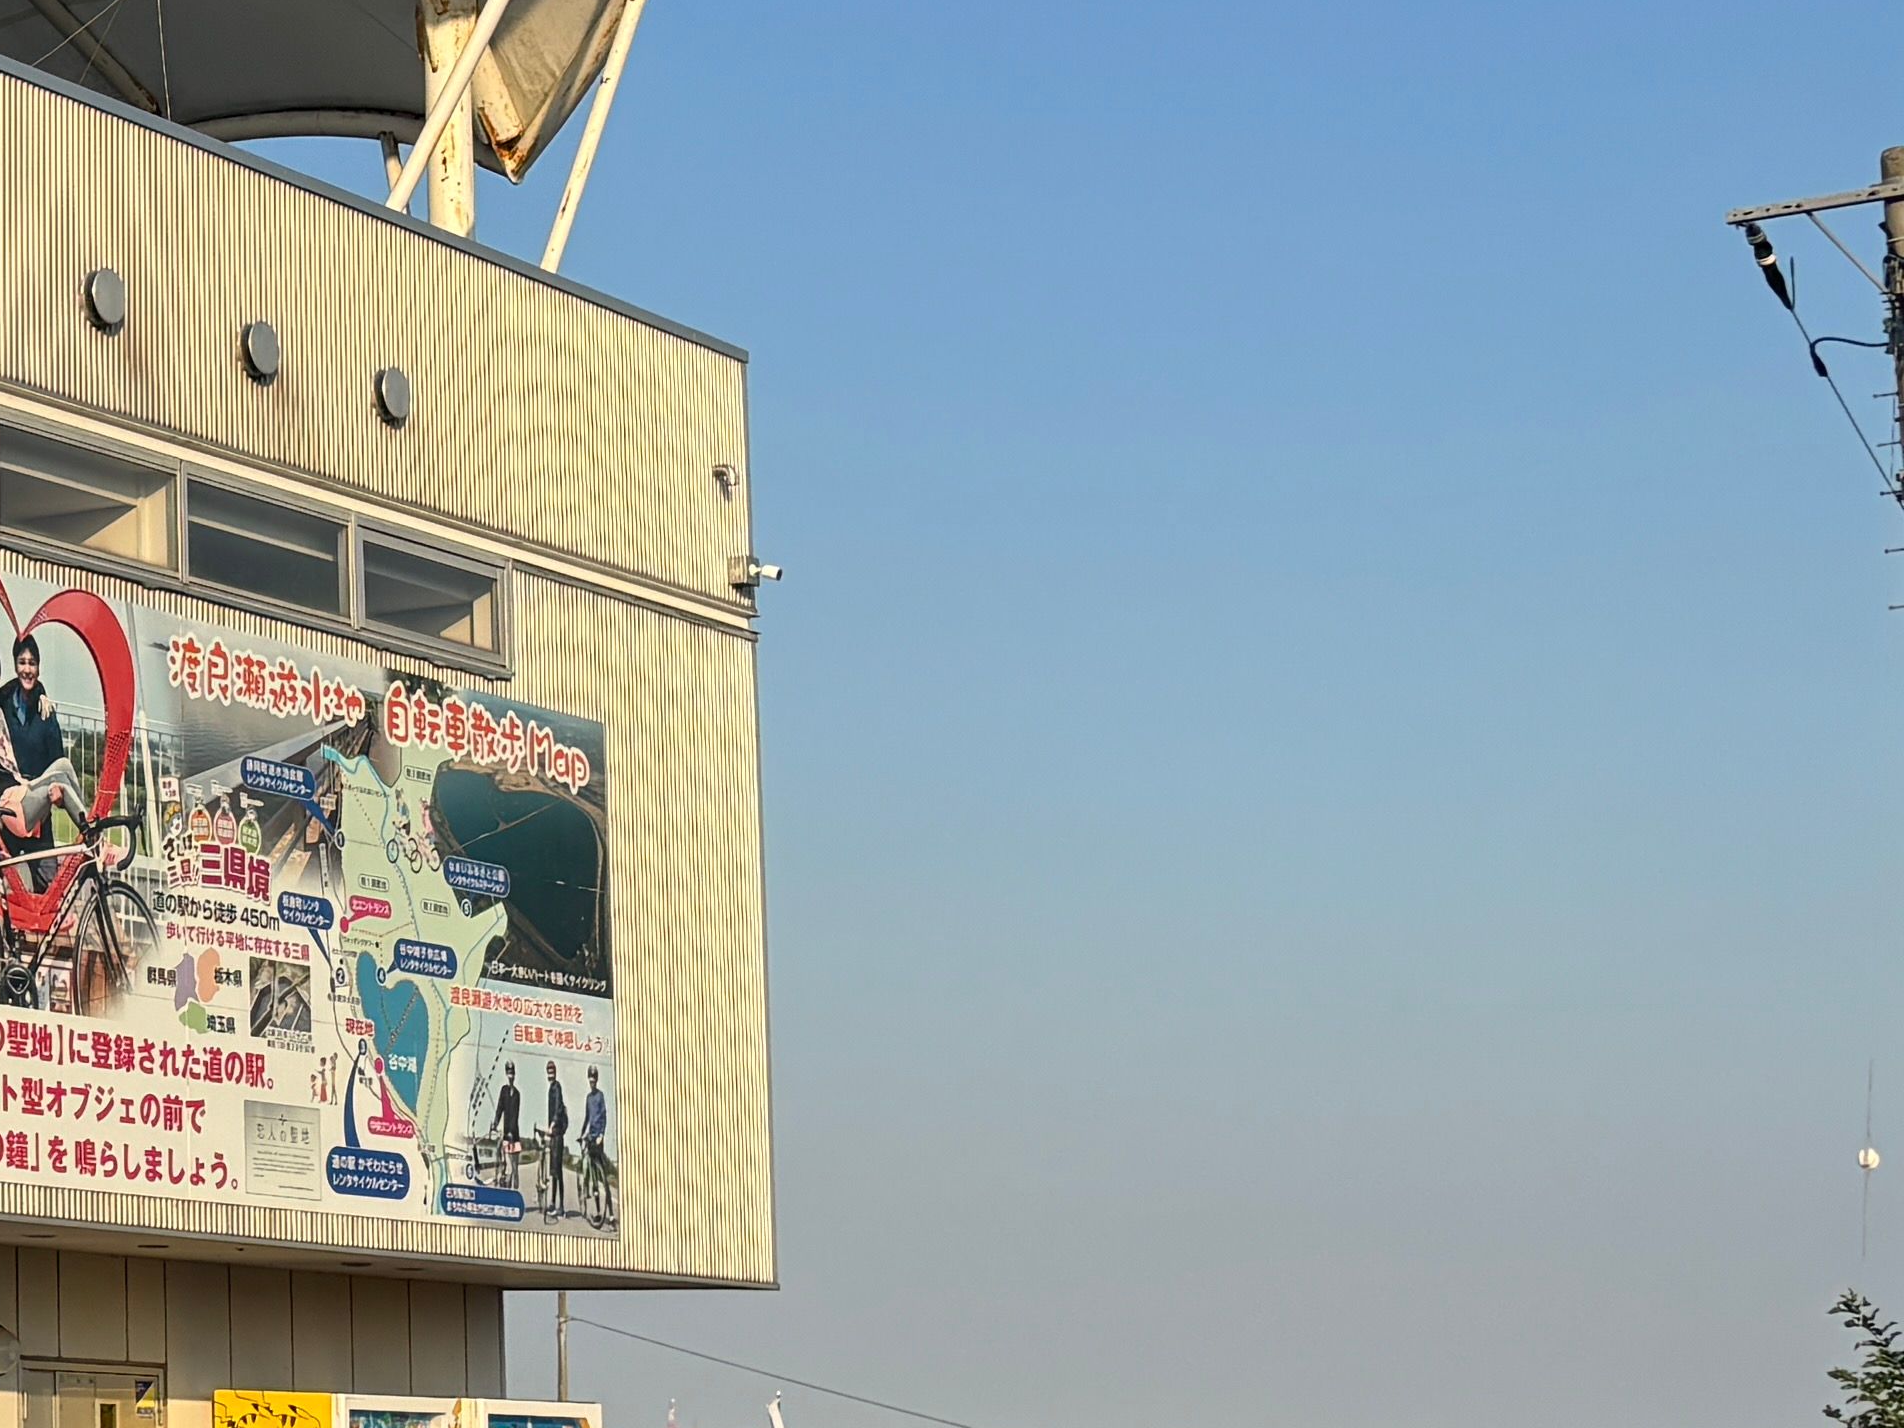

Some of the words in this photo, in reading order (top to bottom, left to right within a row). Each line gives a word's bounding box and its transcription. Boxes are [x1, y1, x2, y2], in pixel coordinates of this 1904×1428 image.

[170, 637, 365, 724] 渡良瀬遊水地
[200, 843, 270, 902] 三県境
[152, 892, 237, 925] 道の駅から徒歩
[240, 906, 281, 932] 450m
[147, 965, 177, 988] 群馬県
[214, 967, 242, 988] 栃木県
[206, 1013, 236, 1034] 埼玉県
[345, 1018, 374, 1038] 現在地
[387, 1053, 417, 1073] 谷中湖
[331, 1154, 355, 1170] 道の駅
[357, 1156, 404, 1176] かぞわたらせ
[332, 1173, 406, 1192] レンタサイクルセンター
